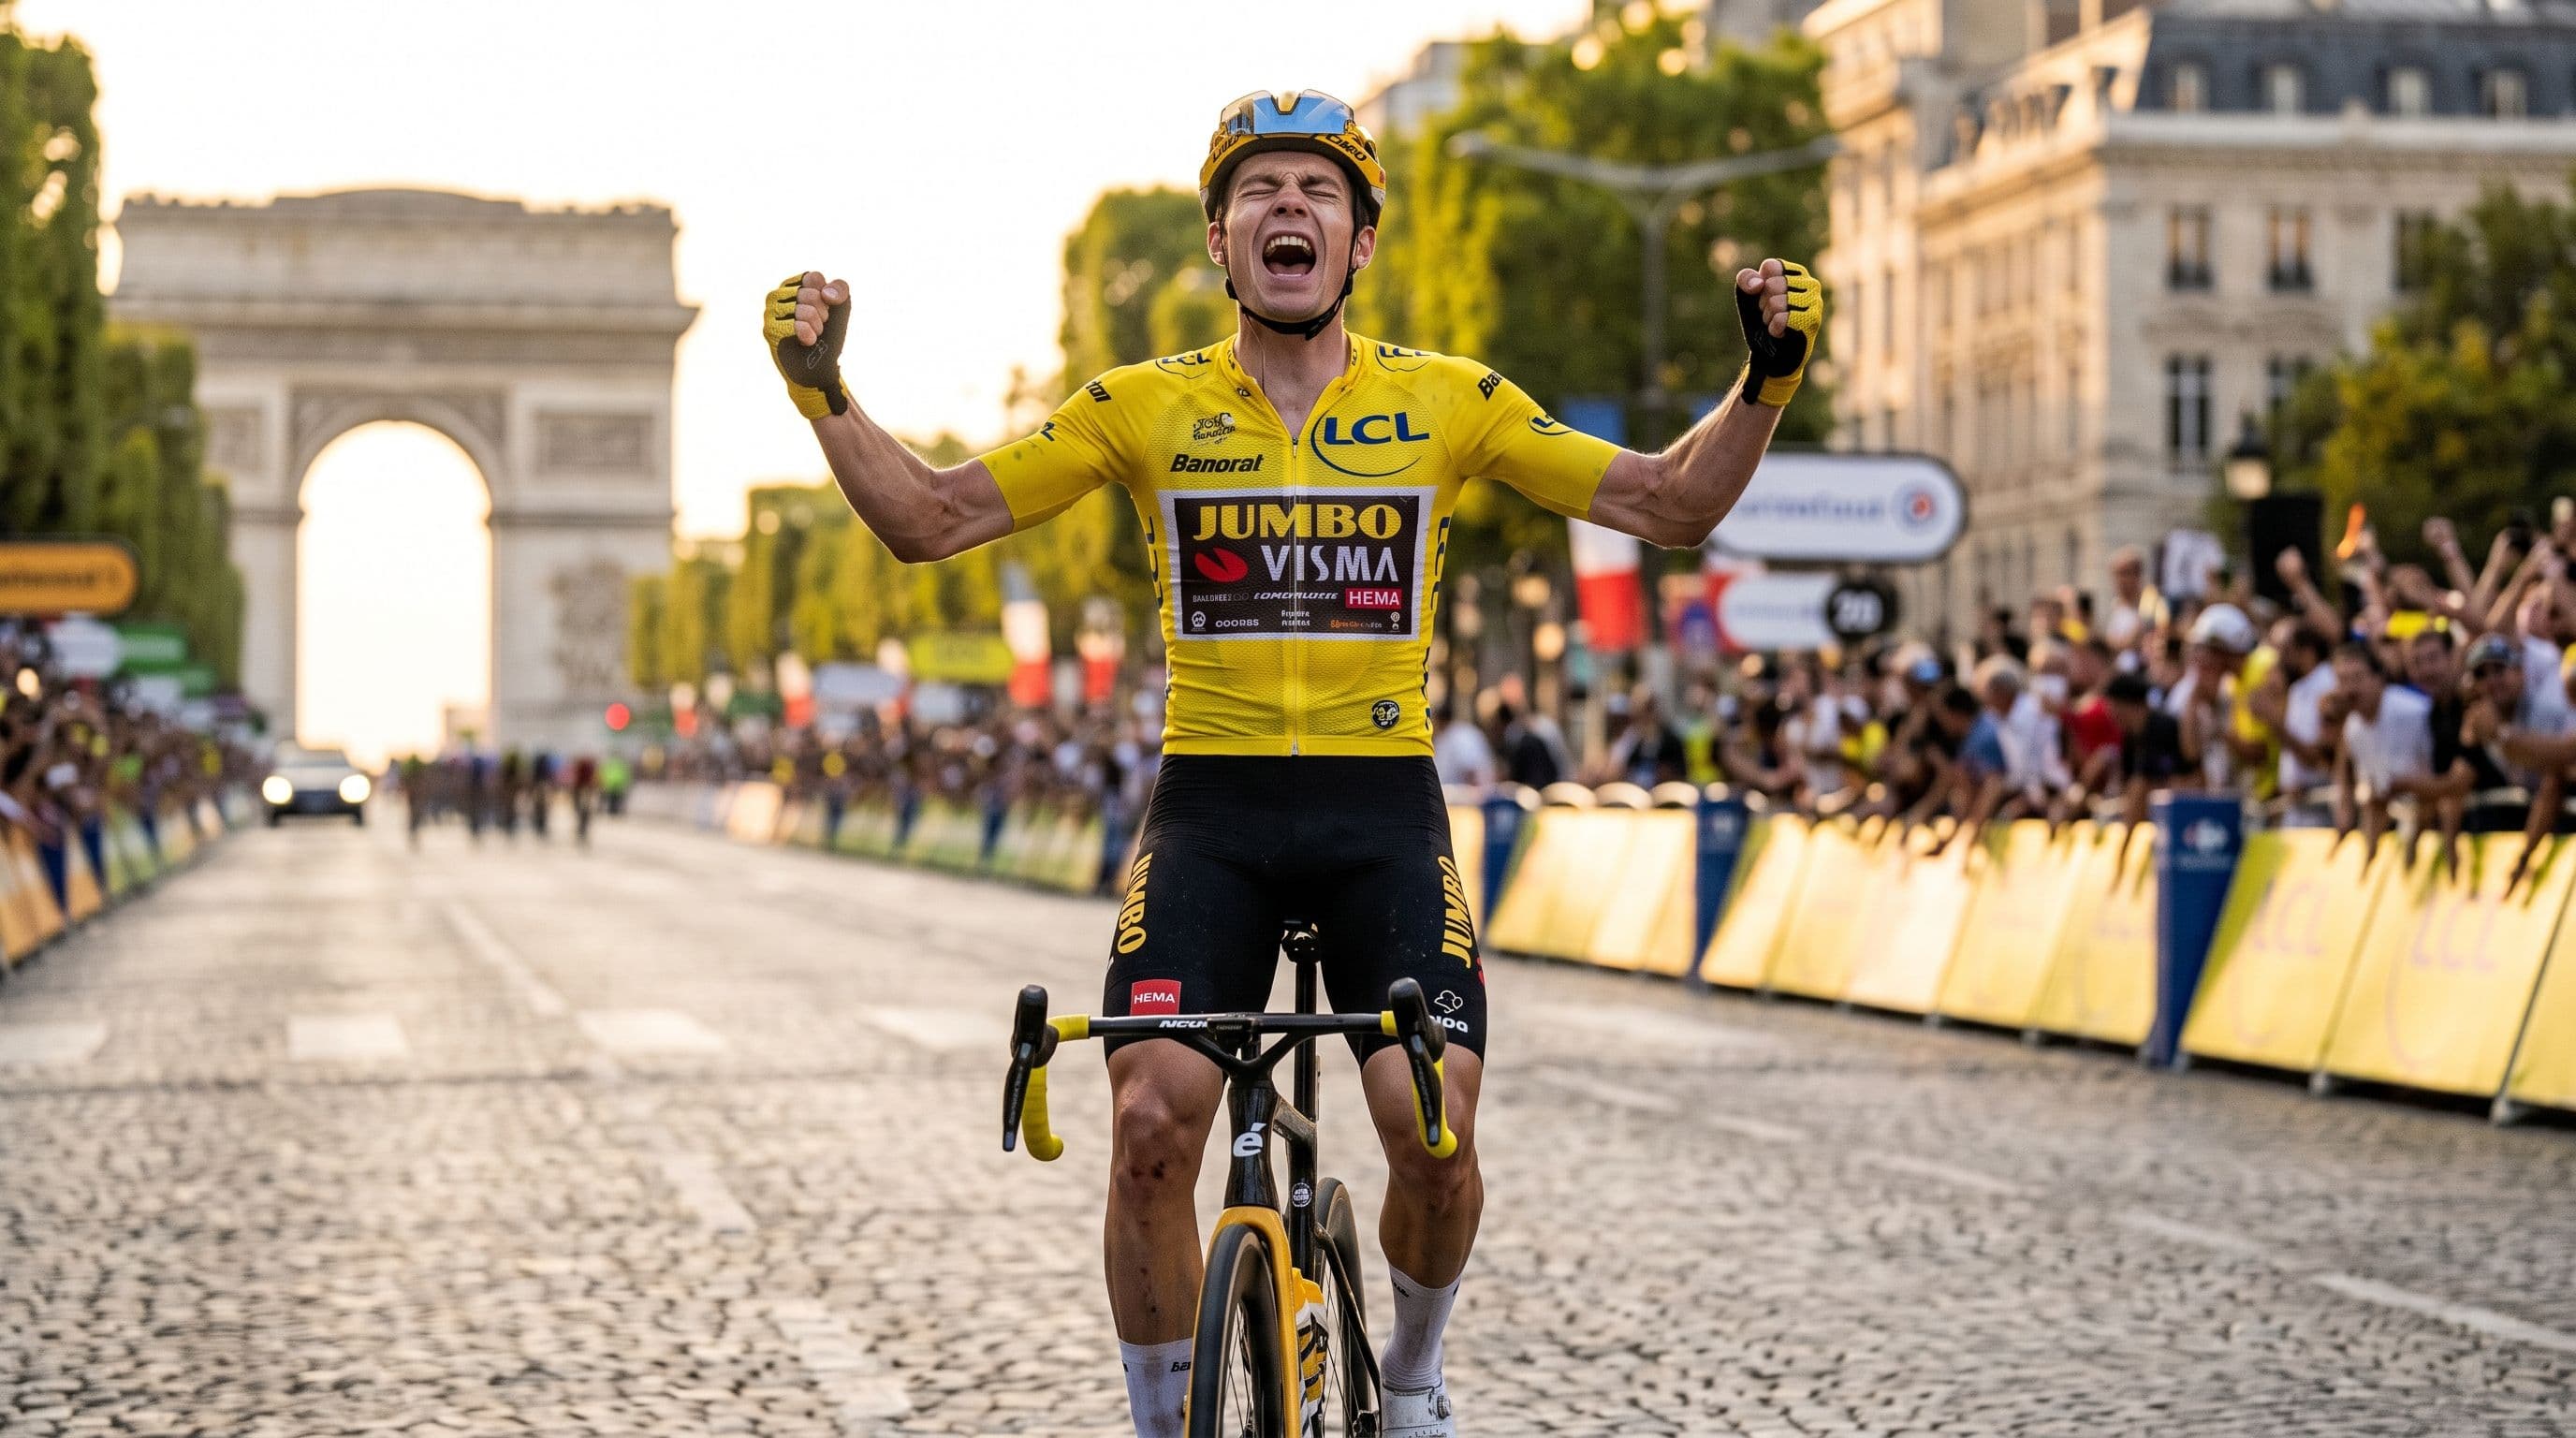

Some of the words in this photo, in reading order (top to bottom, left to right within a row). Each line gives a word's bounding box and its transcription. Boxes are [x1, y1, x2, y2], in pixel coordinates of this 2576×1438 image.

[1324, 412, 1430, 446] LCL
[1170, 453, 1264, 473] Banorat
[1193, 504, 1402, 541] JUMBO
[1260, 545, 1399, 581] VISMA
[1349, 591, 1400, 606] HEMA
[1117, 852, 1153, 954] JUMBO
[1437, 856, 1473, 969] JUMBO
[1134, 991, 1176, 1005] HEMA
